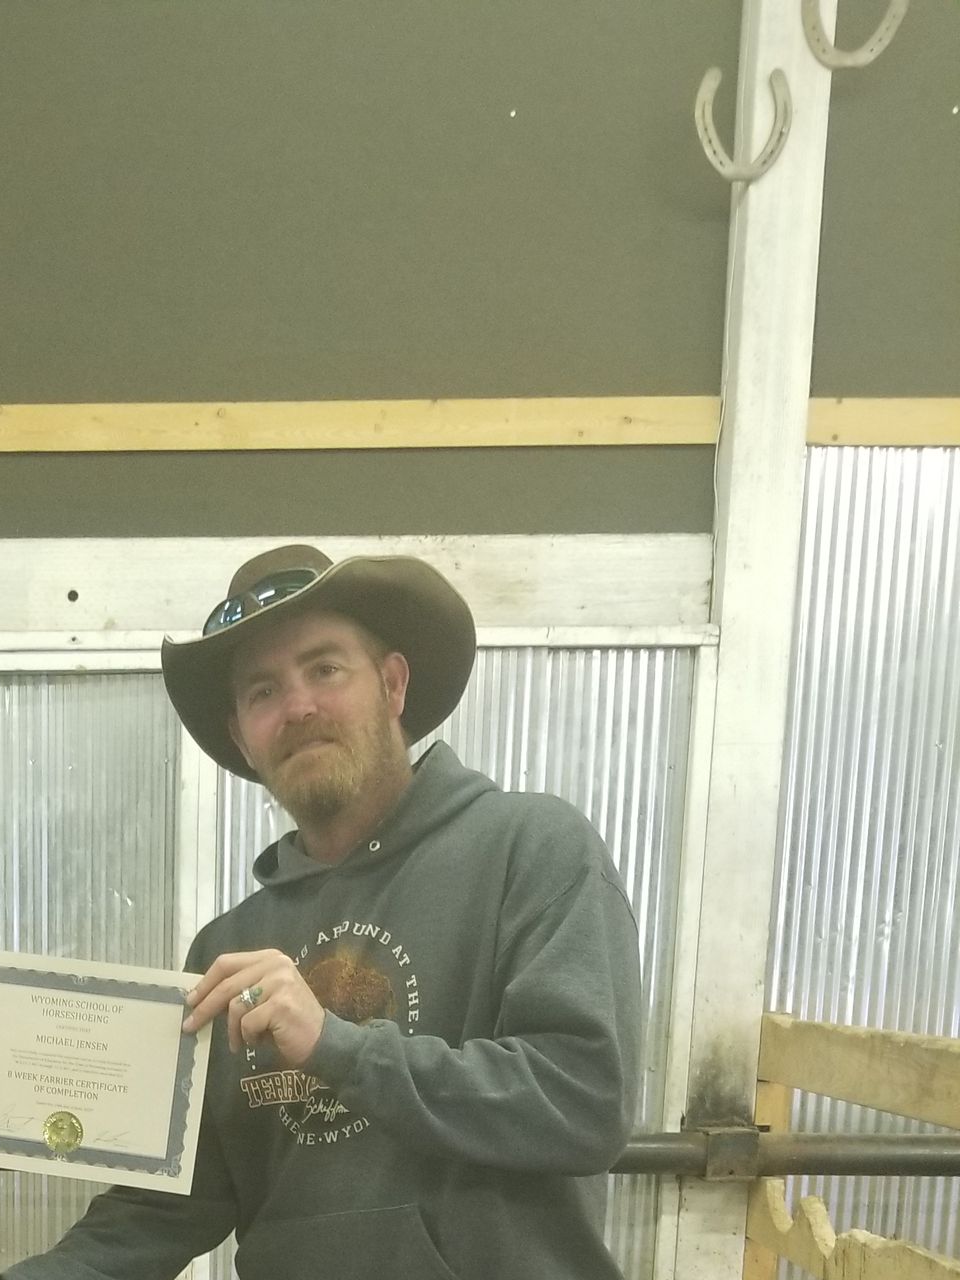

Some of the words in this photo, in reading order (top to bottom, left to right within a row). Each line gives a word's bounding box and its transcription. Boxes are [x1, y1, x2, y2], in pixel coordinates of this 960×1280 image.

[392, 944, 410, 967] AT
[406, 974, 419, 1023] THE
[31, 994, 74, 1008] WYOMING
[75, 1000, 110, 1013] SCHOOL
[111, 1004, 124, 1014] OF
[42, 1008, 110, 1024] HORSESHOEING
[36, 1034, 75, 1048] MICHAEL
[76, 1040, 109, 1051] JENSEN
[14, 1071, 39, 1082] WEEK
[39, 1074, 74, 1087] FARRIER
[75, 1079, 129, 1094] CERTIFICATE
[34, 1085, 46, 1093] OF
[46, 1086, 99, 1101] COMPLETION
